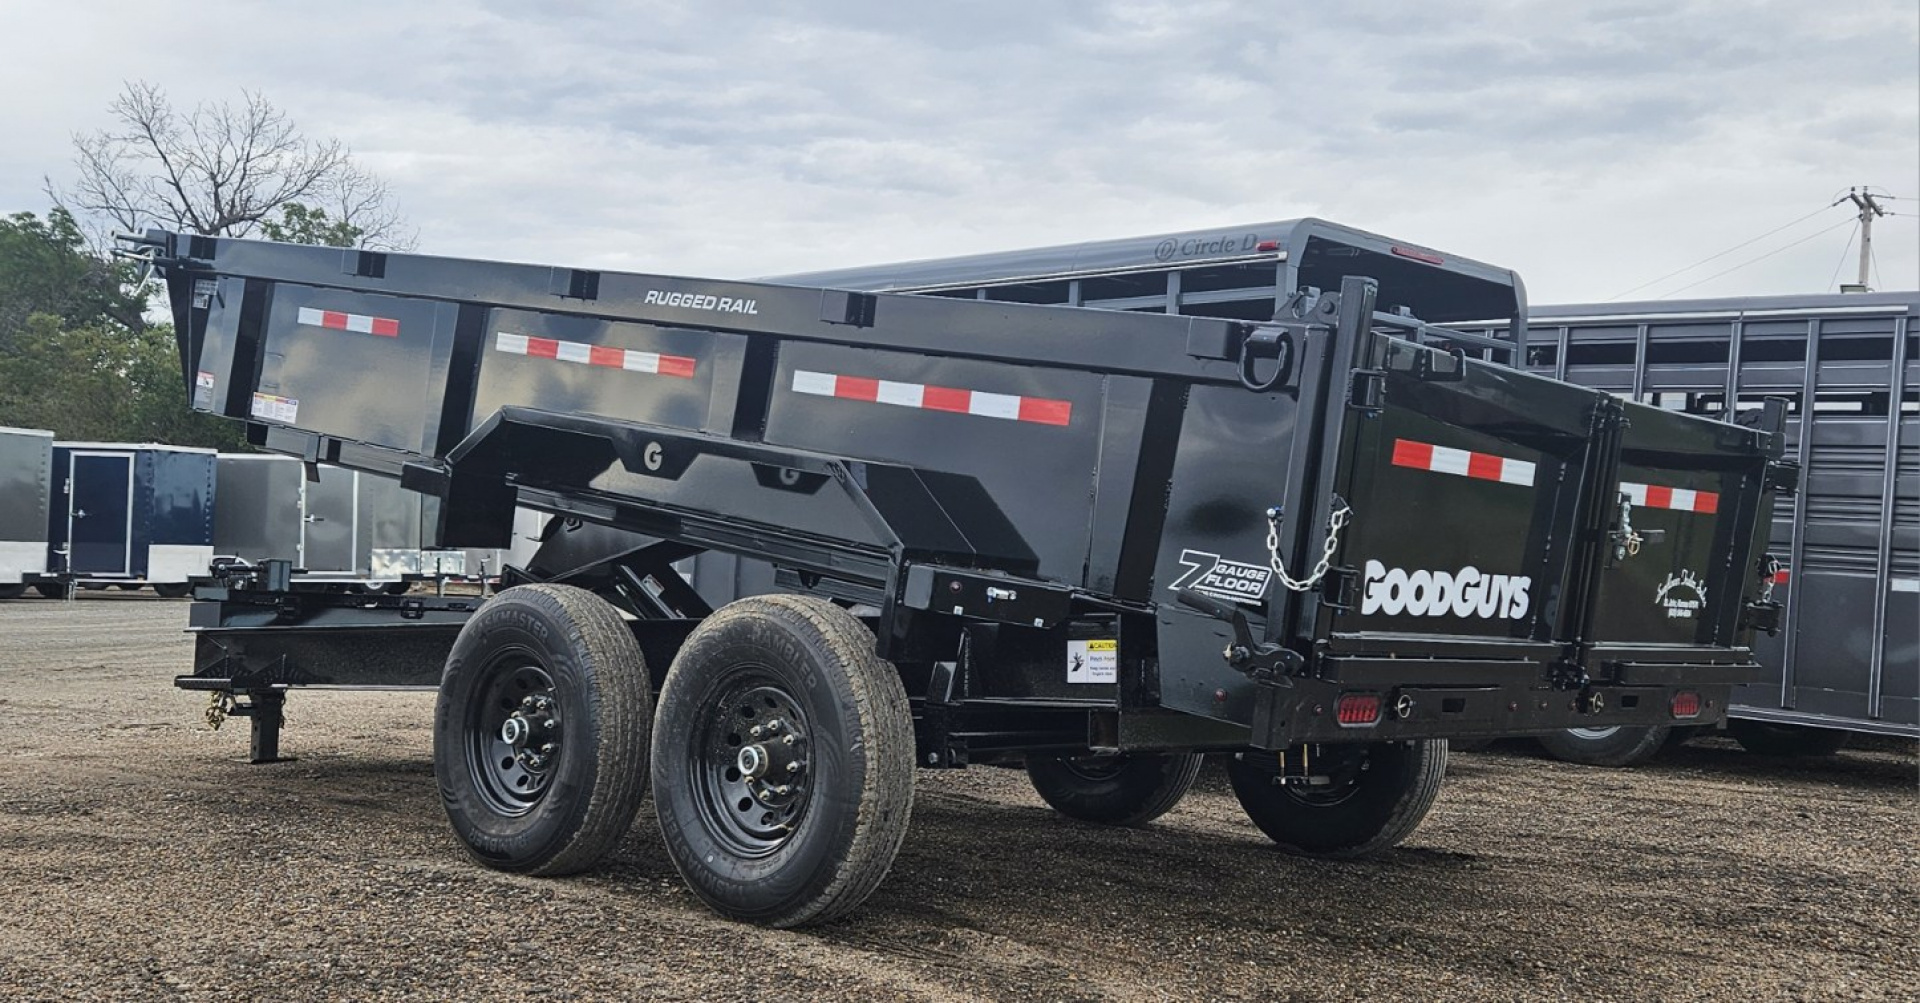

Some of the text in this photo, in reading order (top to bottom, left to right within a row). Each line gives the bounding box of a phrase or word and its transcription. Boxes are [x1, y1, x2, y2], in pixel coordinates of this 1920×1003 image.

[1181, 236, 1235, 256] Circle
[1240, 233, 1258, 251] D
[644, 290, 758, 314] RUGGED RAIL
[644, 441, 662, 471] G
[1168, 549, 1220, 591] 7
[1216, 564, 1267, 581] GAUGE
[1204, 574, 1262, 593] FLOOR
